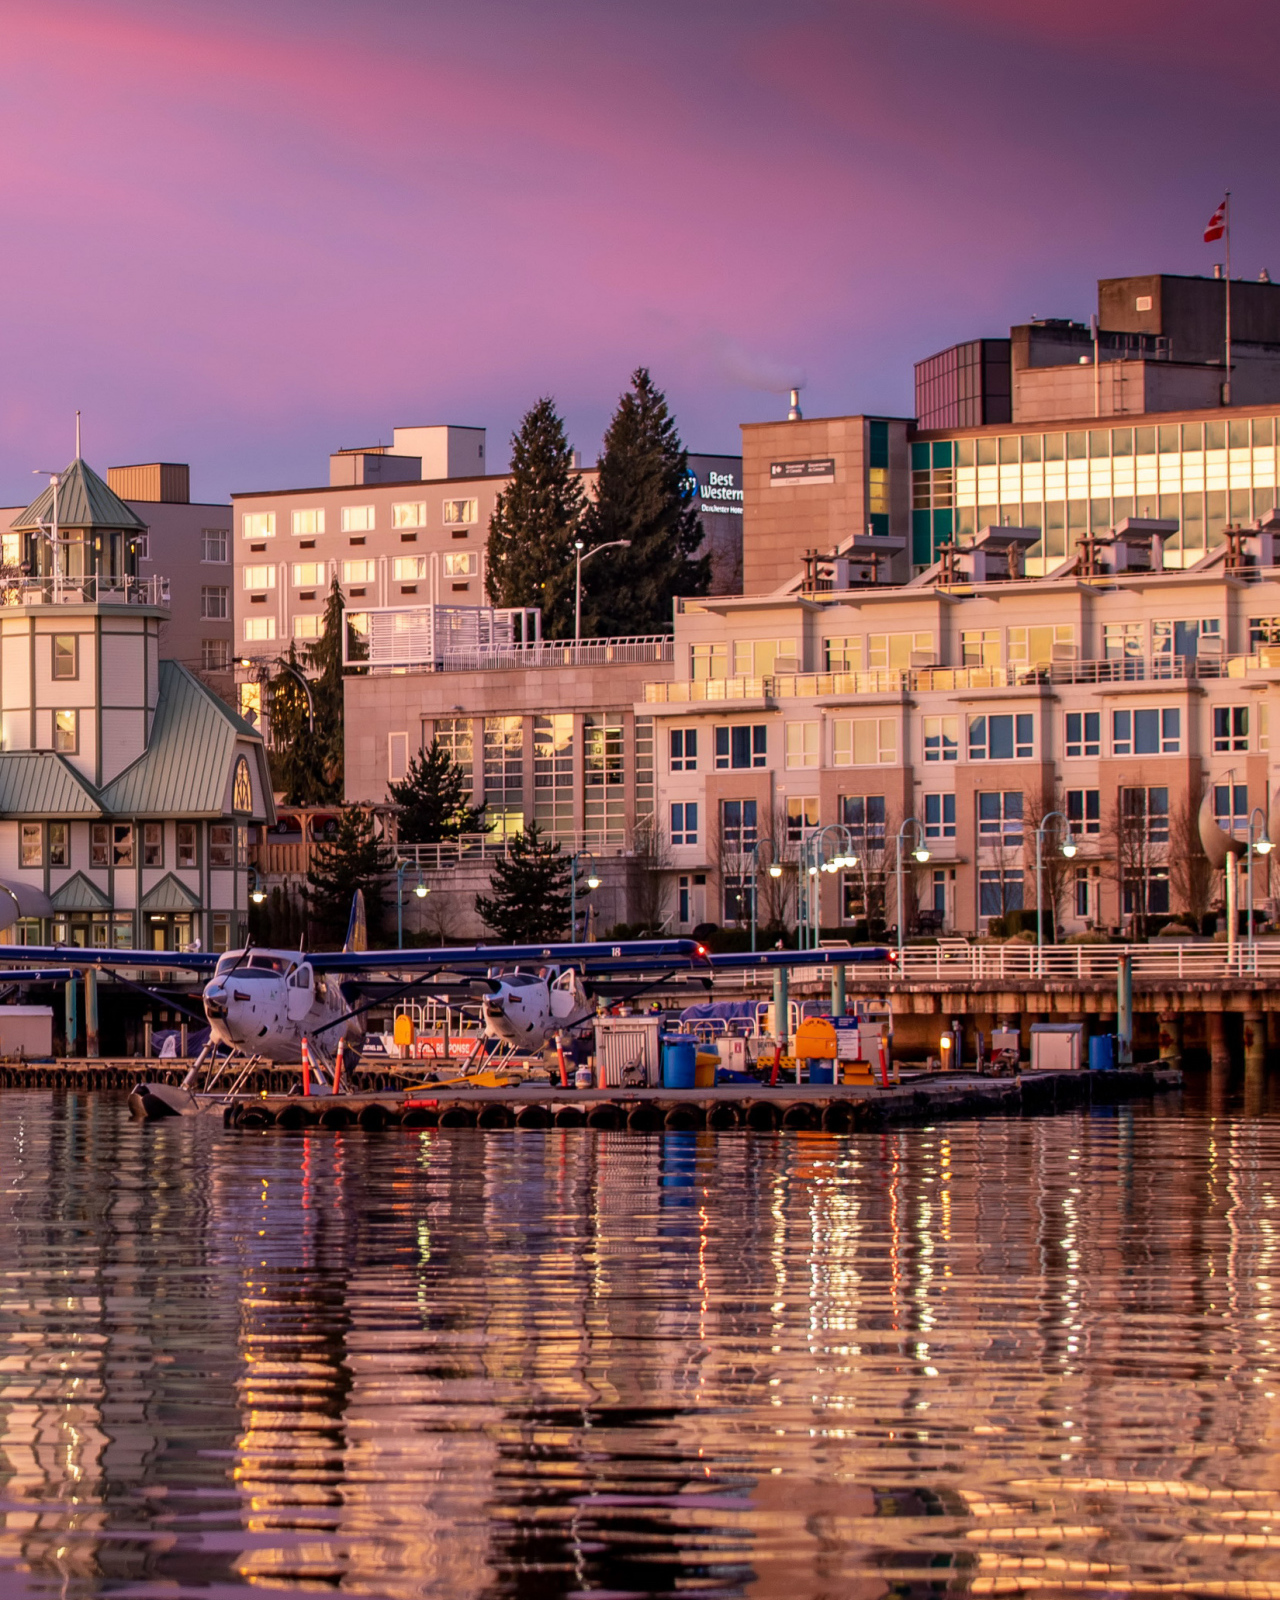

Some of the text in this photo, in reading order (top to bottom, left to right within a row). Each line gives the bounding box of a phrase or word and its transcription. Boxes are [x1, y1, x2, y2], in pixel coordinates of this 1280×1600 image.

[709, 471, 734, 487] Best
[700, 485, 743, 500] Western
[730, 506, 743, 514] Hote
[611, 947, 621, 957] 18
[35, 972, 41, 980] 2
[436, 1043, 470, 1054] REPONSE
